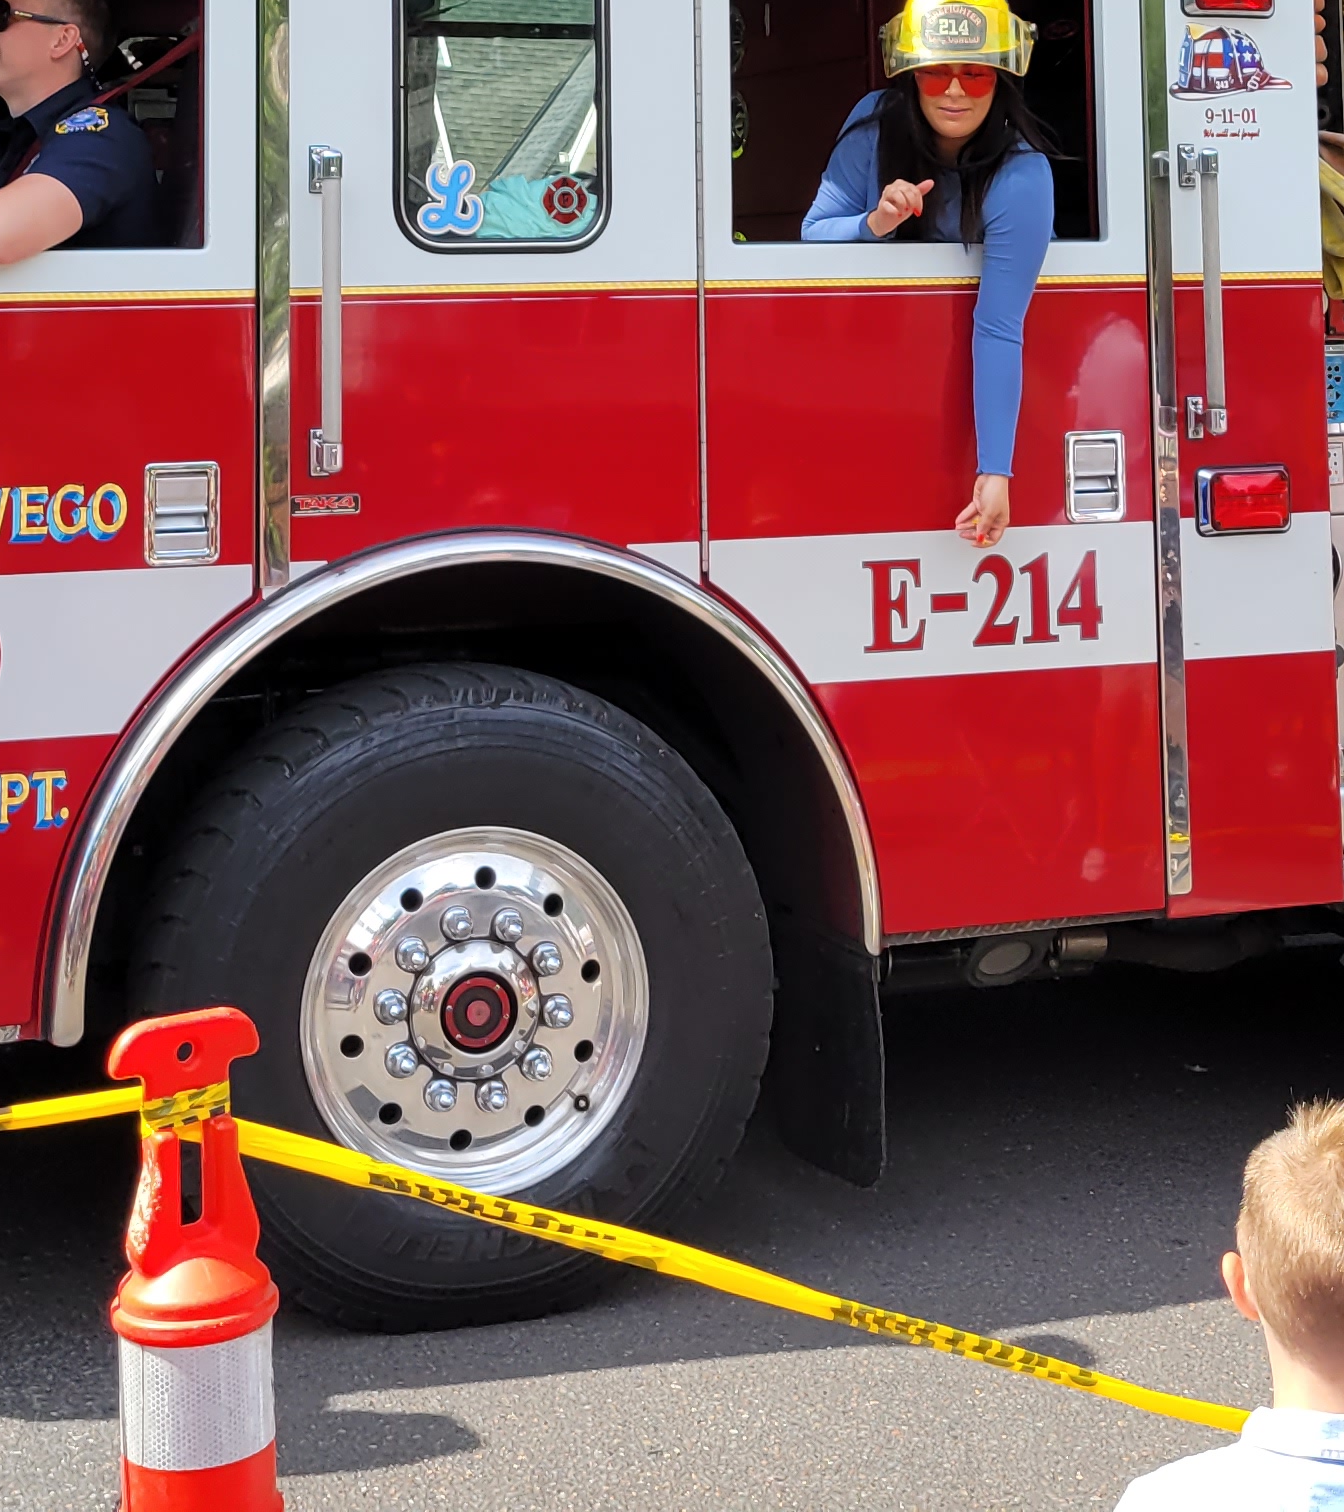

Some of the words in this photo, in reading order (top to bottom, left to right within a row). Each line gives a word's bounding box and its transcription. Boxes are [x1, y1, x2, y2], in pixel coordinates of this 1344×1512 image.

[937, 18, 970, 36] 214
[1204, 107, 1258, 124] 9-11-01
[861, 549, 1104, 654] E-214
